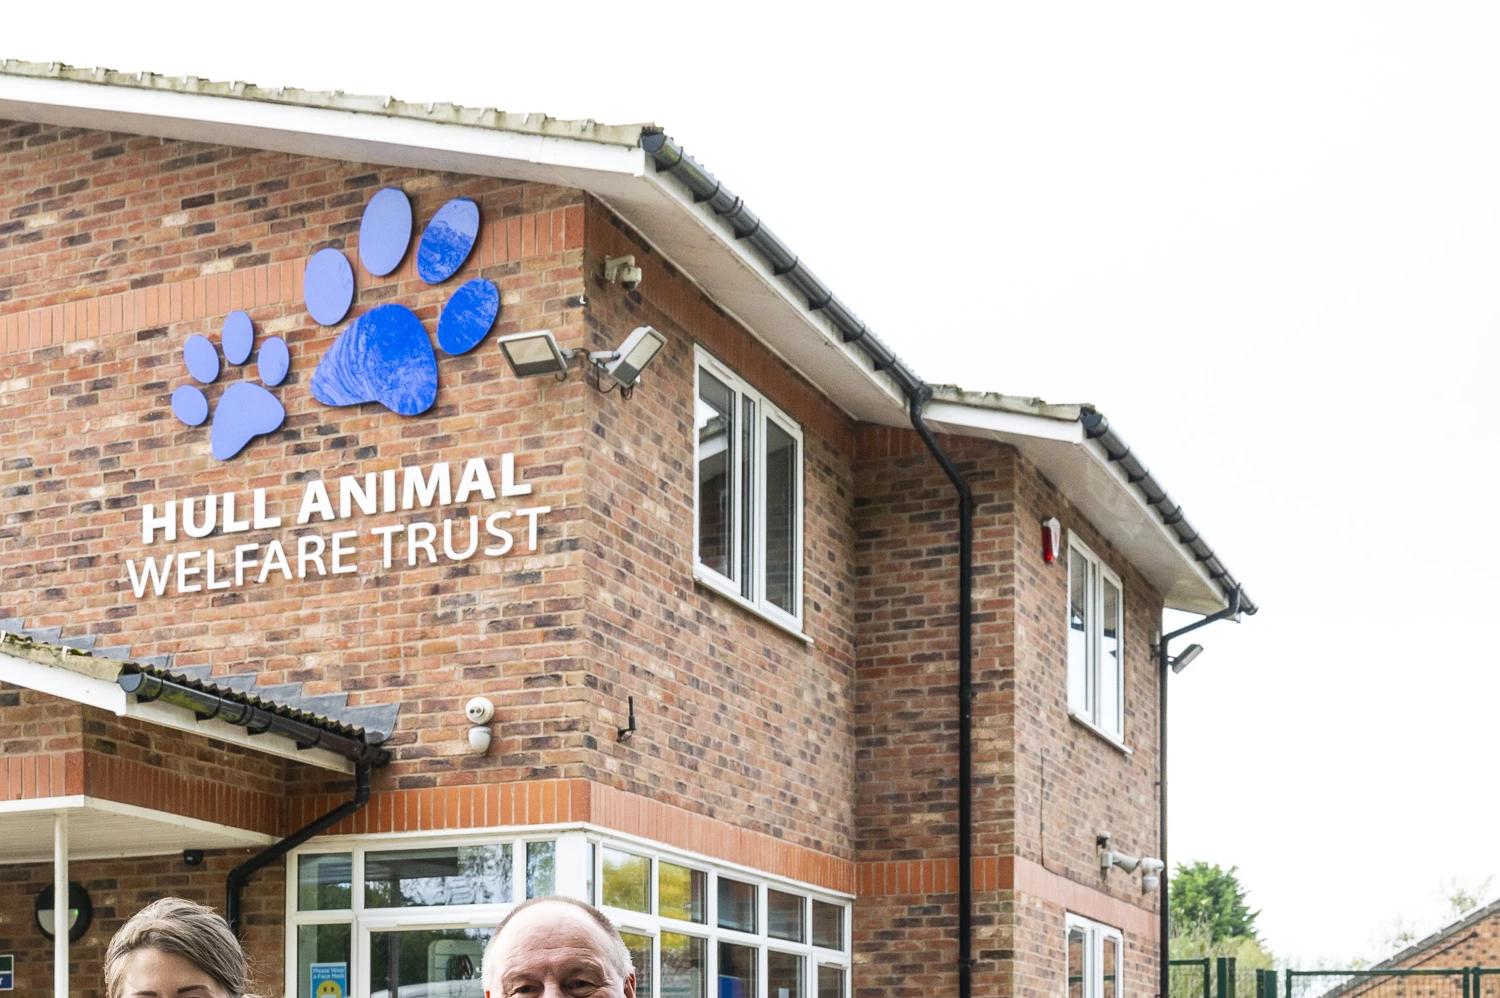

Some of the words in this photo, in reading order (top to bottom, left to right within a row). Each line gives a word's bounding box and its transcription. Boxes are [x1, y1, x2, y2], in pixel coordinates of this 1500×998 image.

[142, 487, 282, 544] HULL
[297, 453, 533, 524] ANIMAL
[125, 530, 359, 598] WELFARE
[371, 505, 552, 569] TRUST
